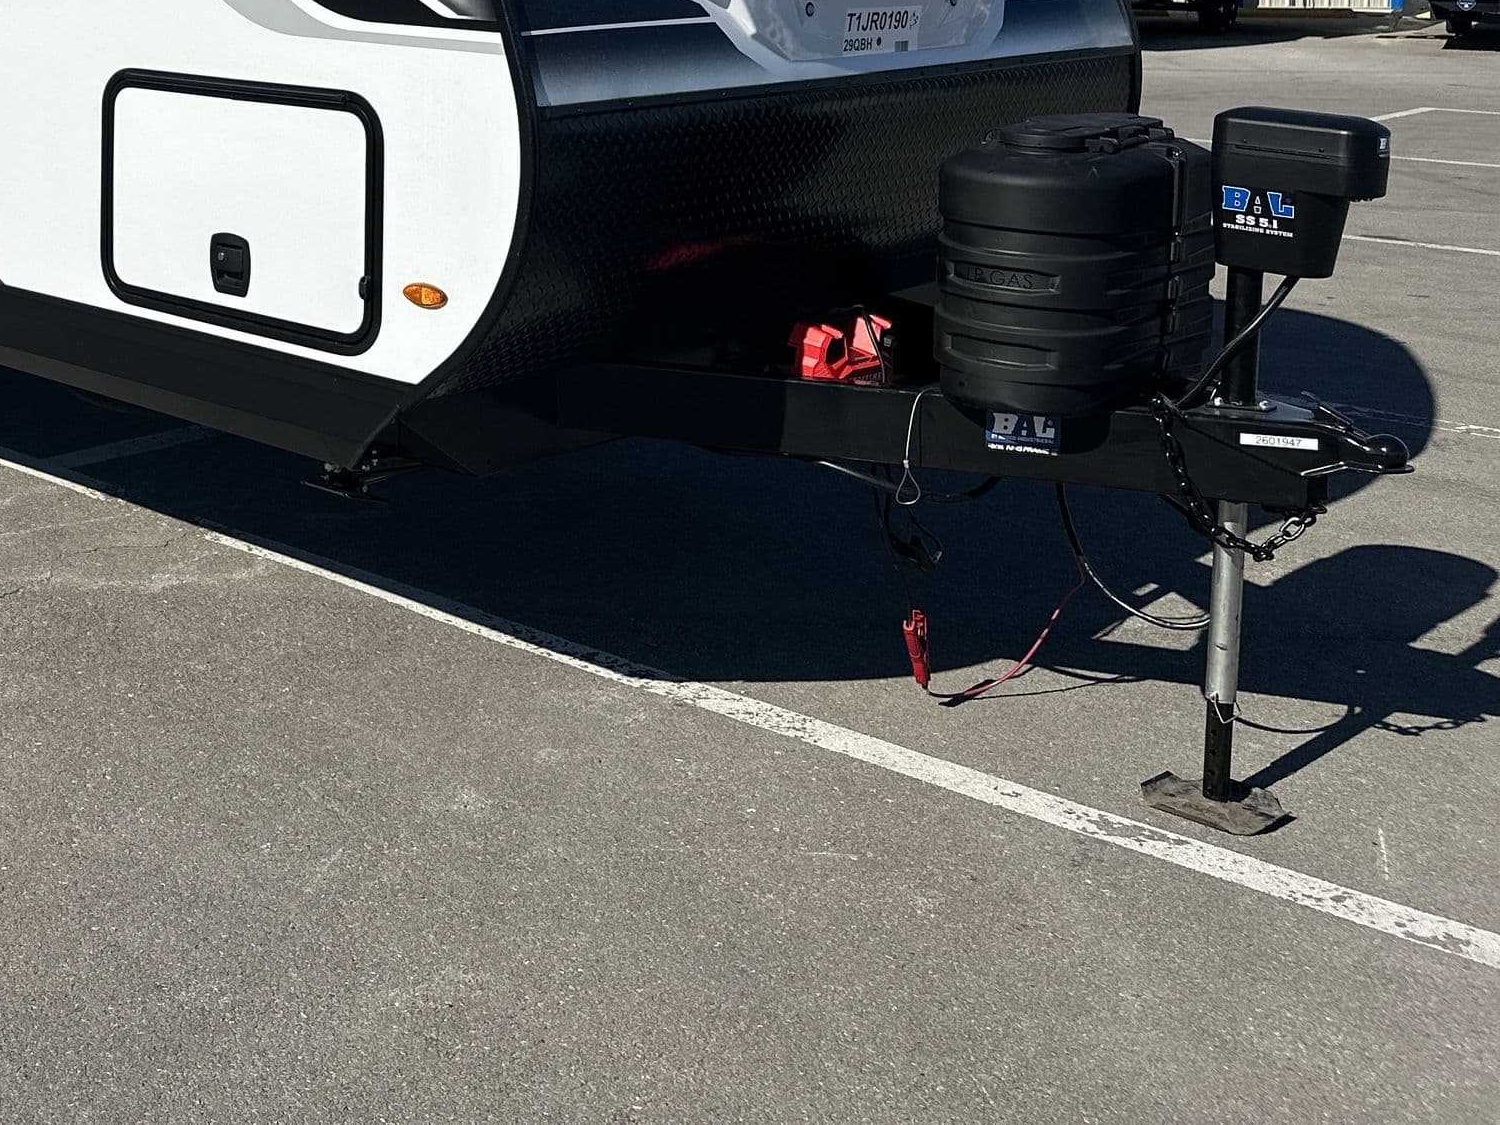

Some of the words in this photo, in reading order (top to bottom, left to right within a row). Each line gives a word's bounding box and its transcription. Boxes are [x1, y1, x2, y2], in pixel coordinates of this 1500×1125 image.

[846, 10, 909, 33] T1JR0190
[843, 37, 873, 52] 29QBH
[1222, 185, 1295, 219] BAL
[1235, 214, 1256, 226] SS
[989, 270, 1034, 289] GAS
[992, 412, 1056, 439] BAL
[1255, 435, 1303, 447] 2601947
